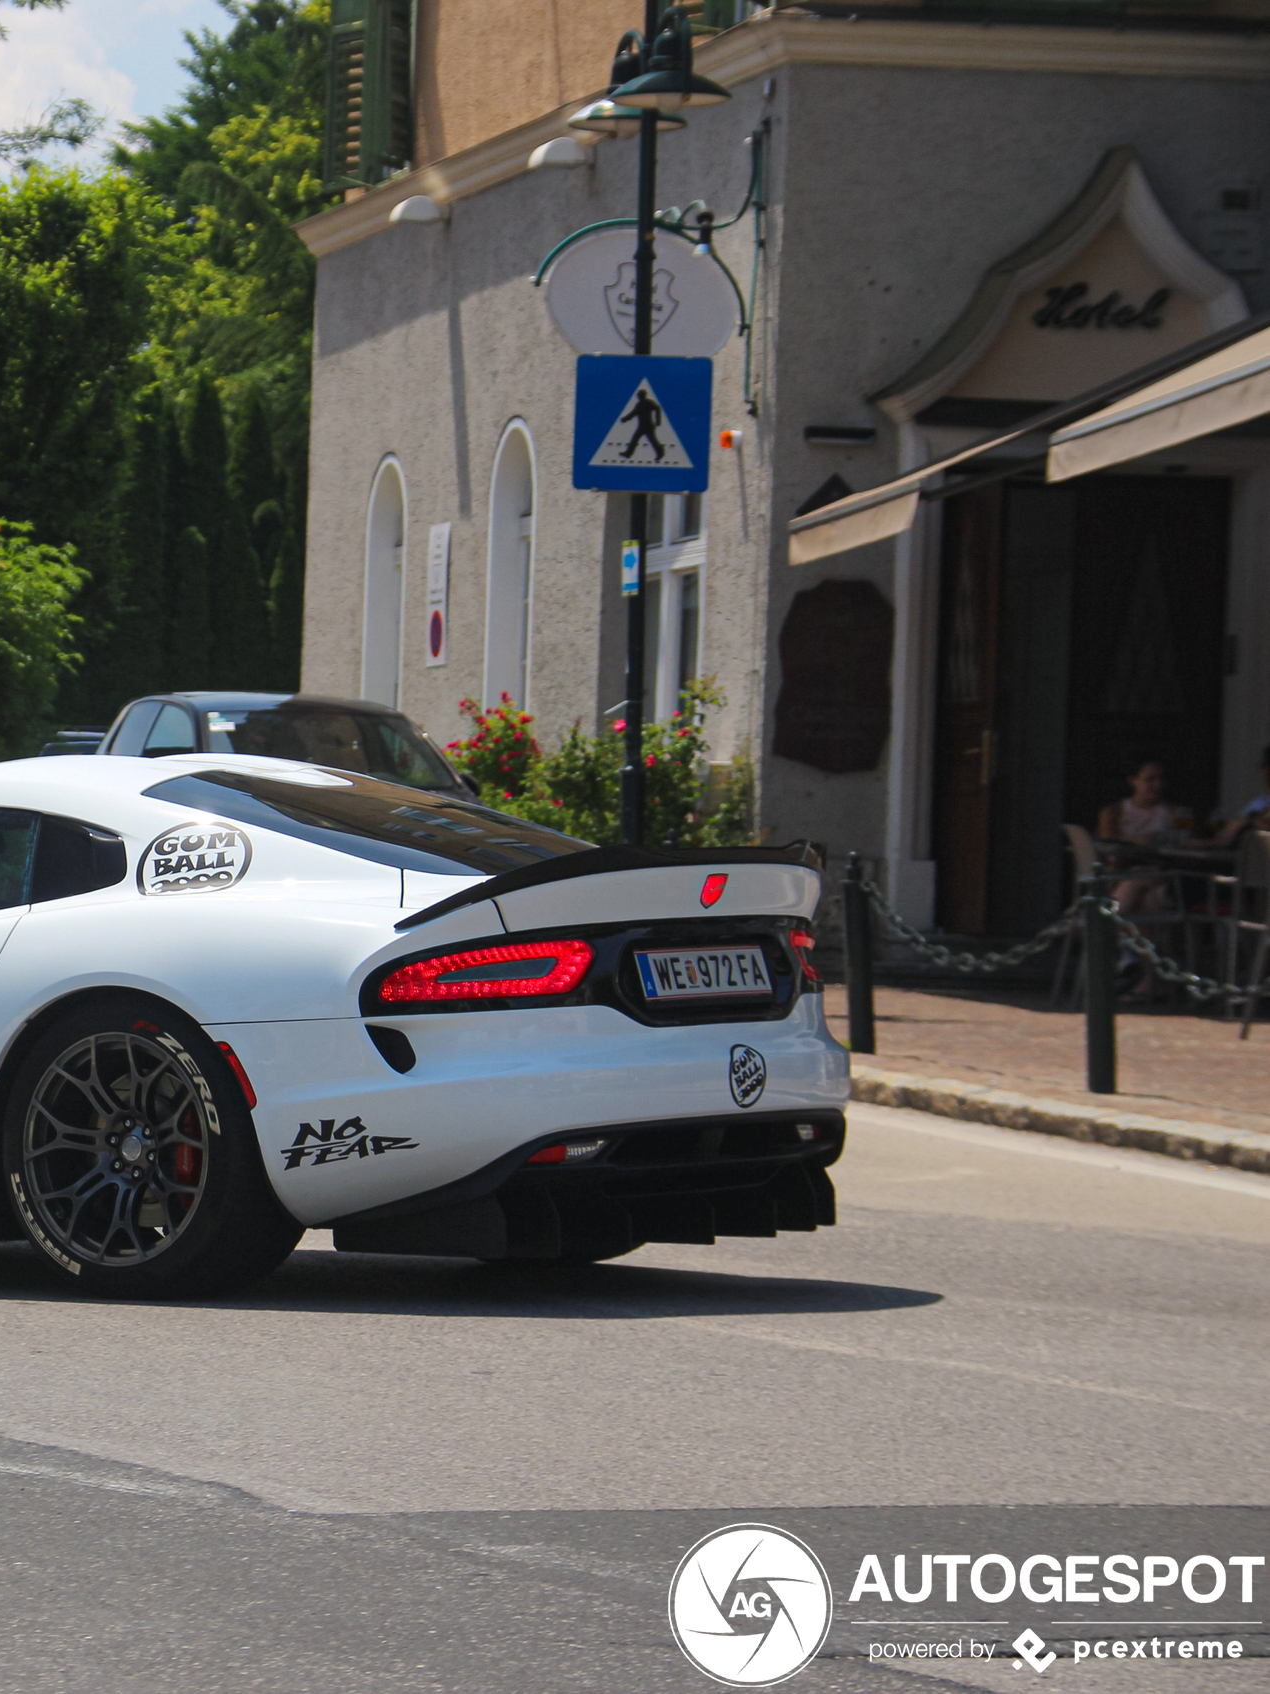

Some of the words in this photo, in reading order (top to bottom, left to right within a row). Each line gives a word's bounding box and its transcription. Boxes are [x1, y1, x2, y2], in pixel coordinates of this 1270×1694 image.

[1033, 281, 1170, 330] Hotel
[154, 831, 239, 855] GUM
[151, 851, 234, 878] BALL
[653, 957, 687, 991] WE
[732, 1047, 756, 1075] GUM
[734, 1061, 762, 1089] BALL
[156, 1031, 221, 1136] ZERO
[291, 1115, 367, 1147] NO
[280, 1135, 420, 1171] FEAR
